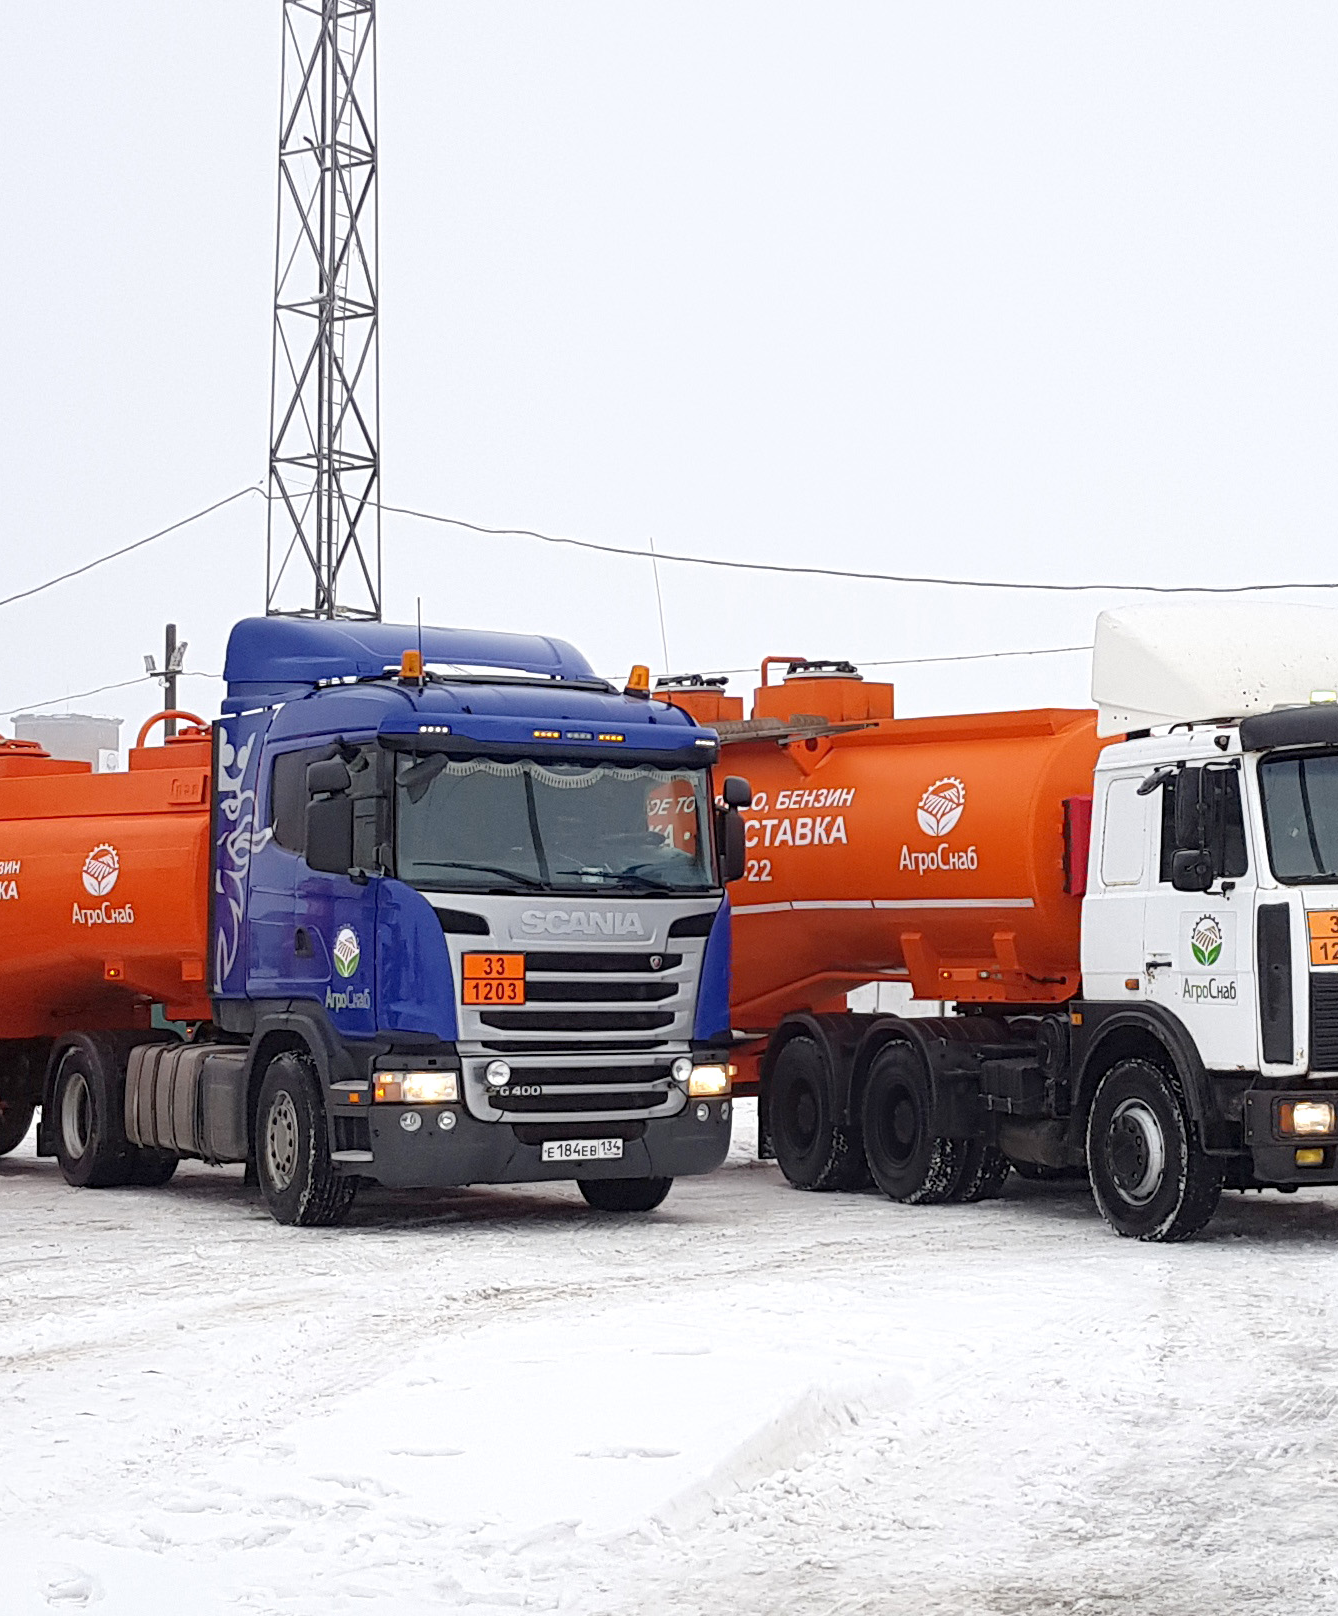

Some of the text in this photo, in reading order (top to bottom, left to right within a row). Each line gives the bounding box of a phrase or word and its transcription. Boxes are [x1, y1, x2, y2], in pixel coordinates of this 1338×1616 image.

[776, 788, 856, 810] БЕНЗИН
[745, 815, 848, 848] СТАВКА
[900, 843, 978, 876] АгроСнаб
[72, 902, 135, 927] АгроСнаб
[521, 910, 644, 936] SCANIA
[483, 957, 506, 975] 33
[325, 985, 371, 1014] АгроСнаб
[472, 982, 517, 1000] 1203
[1183, 978, 1237, 1003] АгроСнаб
[511, 1086, 541, 1096] 400
